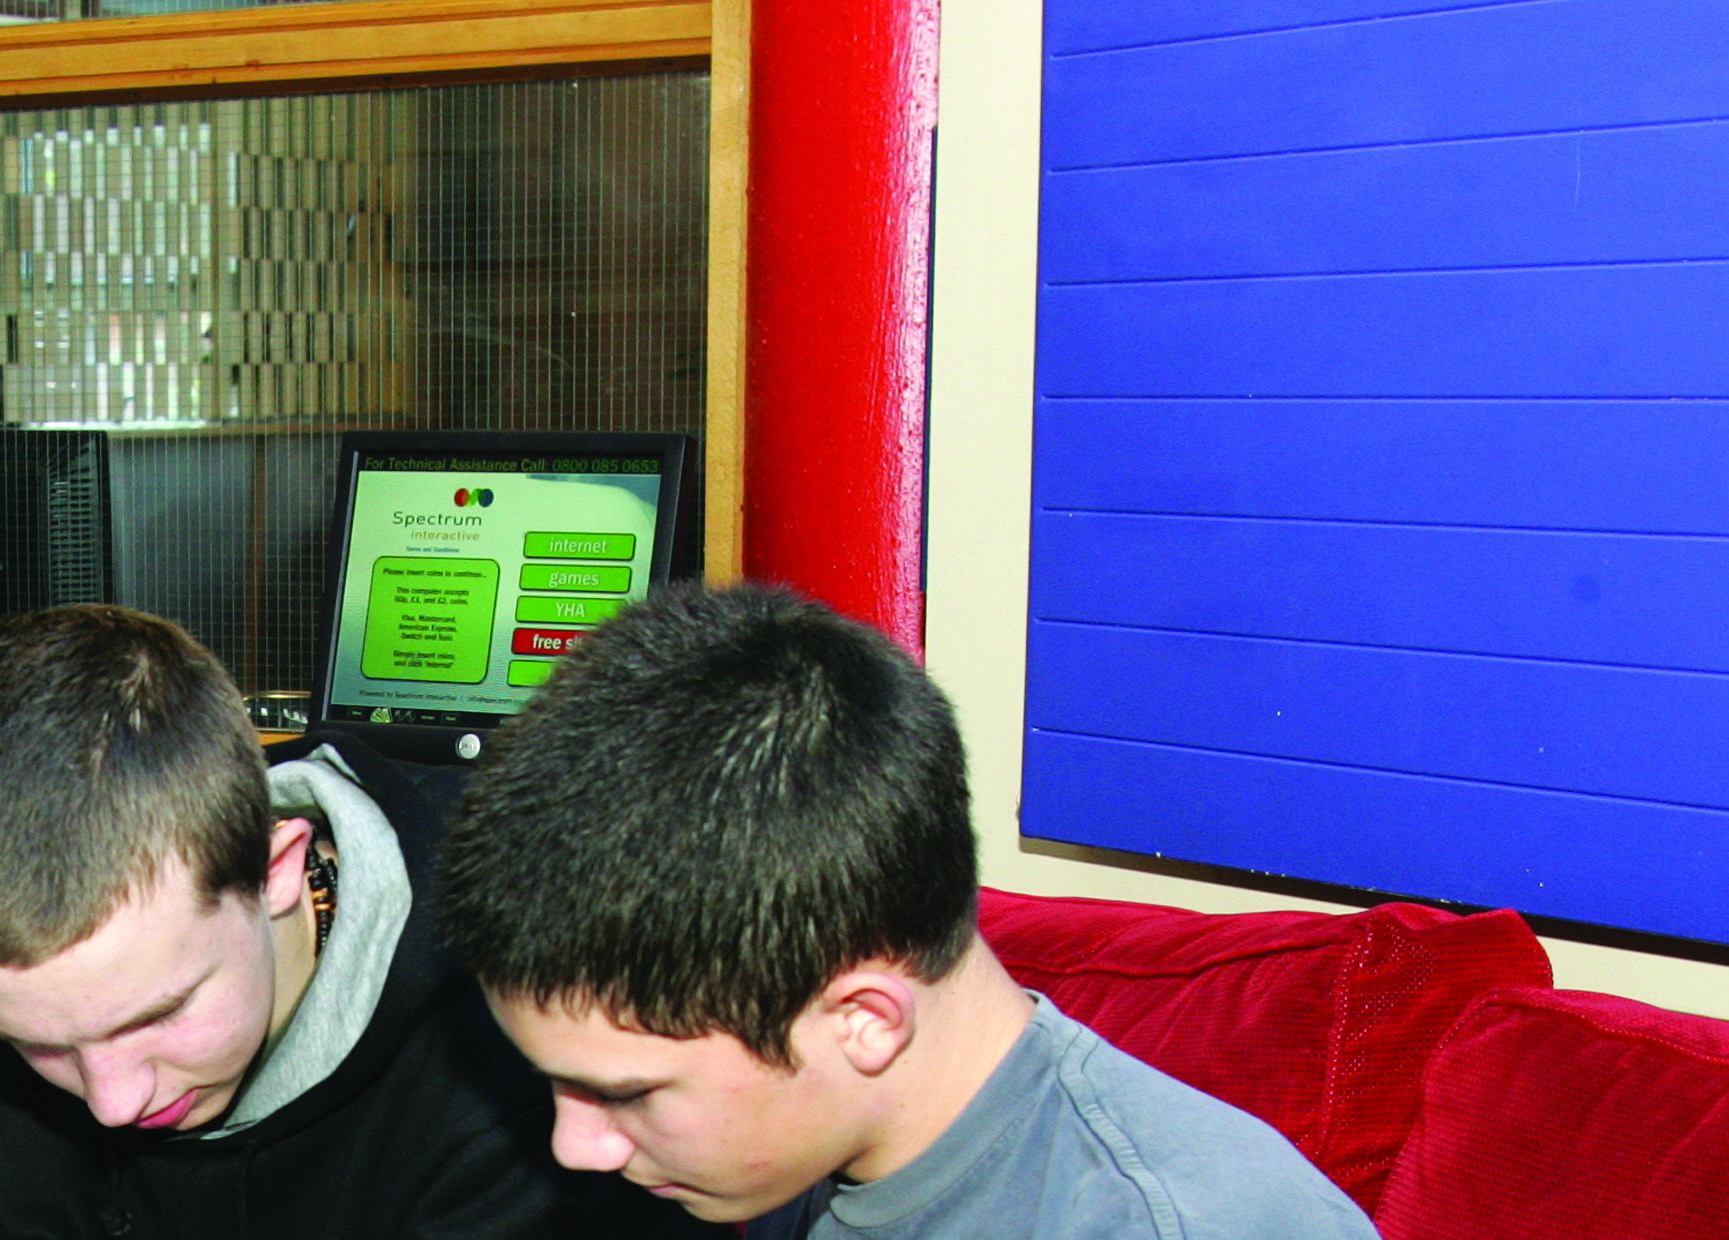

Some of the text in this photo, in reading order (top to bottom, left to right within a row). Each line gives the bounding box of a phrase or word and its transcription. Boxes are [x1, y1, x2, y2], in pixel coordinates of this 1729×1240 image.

[365, 457, 659, 473] For Technical Assistance Call: 0800 085 0653
[392, 511, 482, 528] Spectrum
[411, 530, 480, 542] interactive
[550, 538, 607, 553] internet
[548, 571, 599, 588] games
[556, 602, 585, 618] YHA
[532, 634, 562, 650] free
